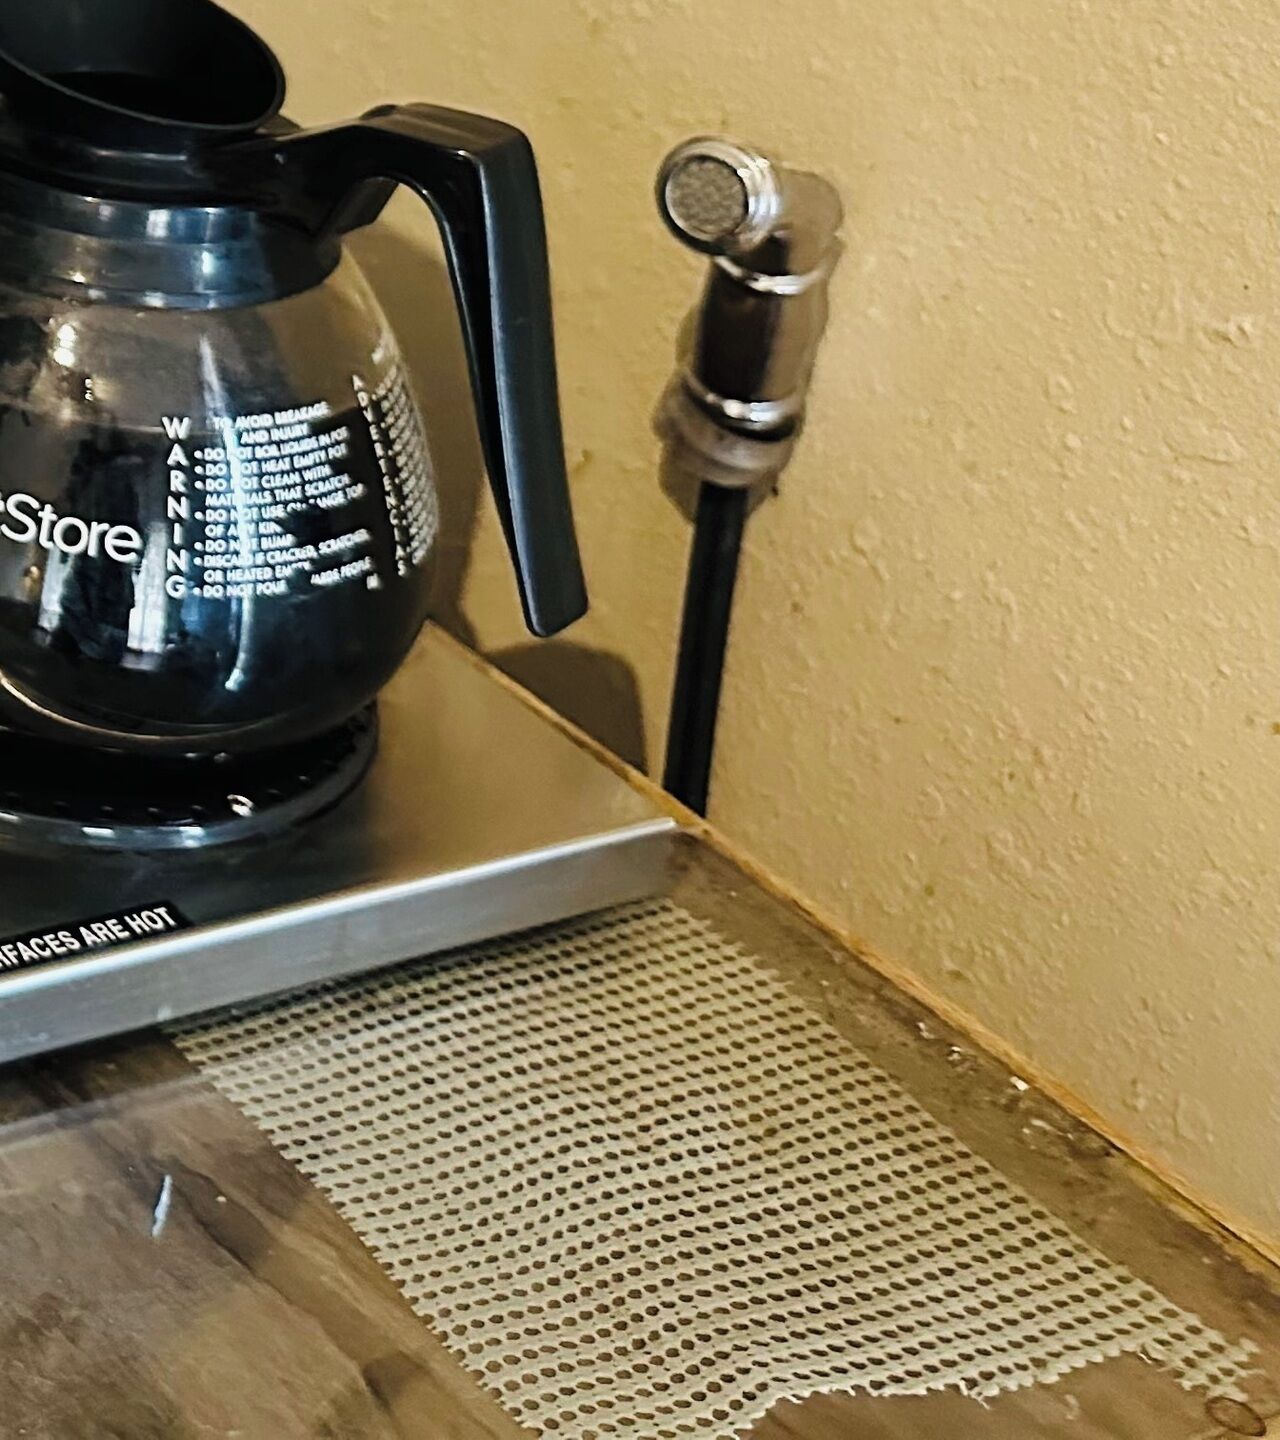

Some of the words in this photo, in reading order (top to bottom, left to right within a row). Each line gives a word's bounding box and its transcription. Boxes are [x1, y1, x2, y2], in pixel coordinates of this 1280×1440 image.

[235, 413, 274, 429] AVOID
[241, 429, 270, 445] AND
[271, 423, 310, 441] INJURY
[204, 447, 225, 461] DO
[205, 462, 226, 476] DO
[261, 458, 289, 475] HEAT
[293, 449, 327, 470] EMPTY
[205, 478, 227, 491] DO
[261, 471, 301, 489] CLEAN
[302, 464, 332, 482] WITH
[205, 489, 273, 507] MATIALS
[274, 486, 302, 503] THAT
[161, 416, 191, 600] WARNING
[205, 509, 227, 522] DO
[261, 503, 287, 519] USE
[204, 524, 225, 537] OF
[205, 539, 227, 553] DO
[260, 534, 296, 550] BUMP
[203, 569, 225, 584] OR
[226, 566, 274, 584] HEATED
[203, 584, 225, 599] DO
[226, 583, 254, 597] NOT
[79, 919, 129, 948] ARE
[126, 905, 178, 936] HOT
